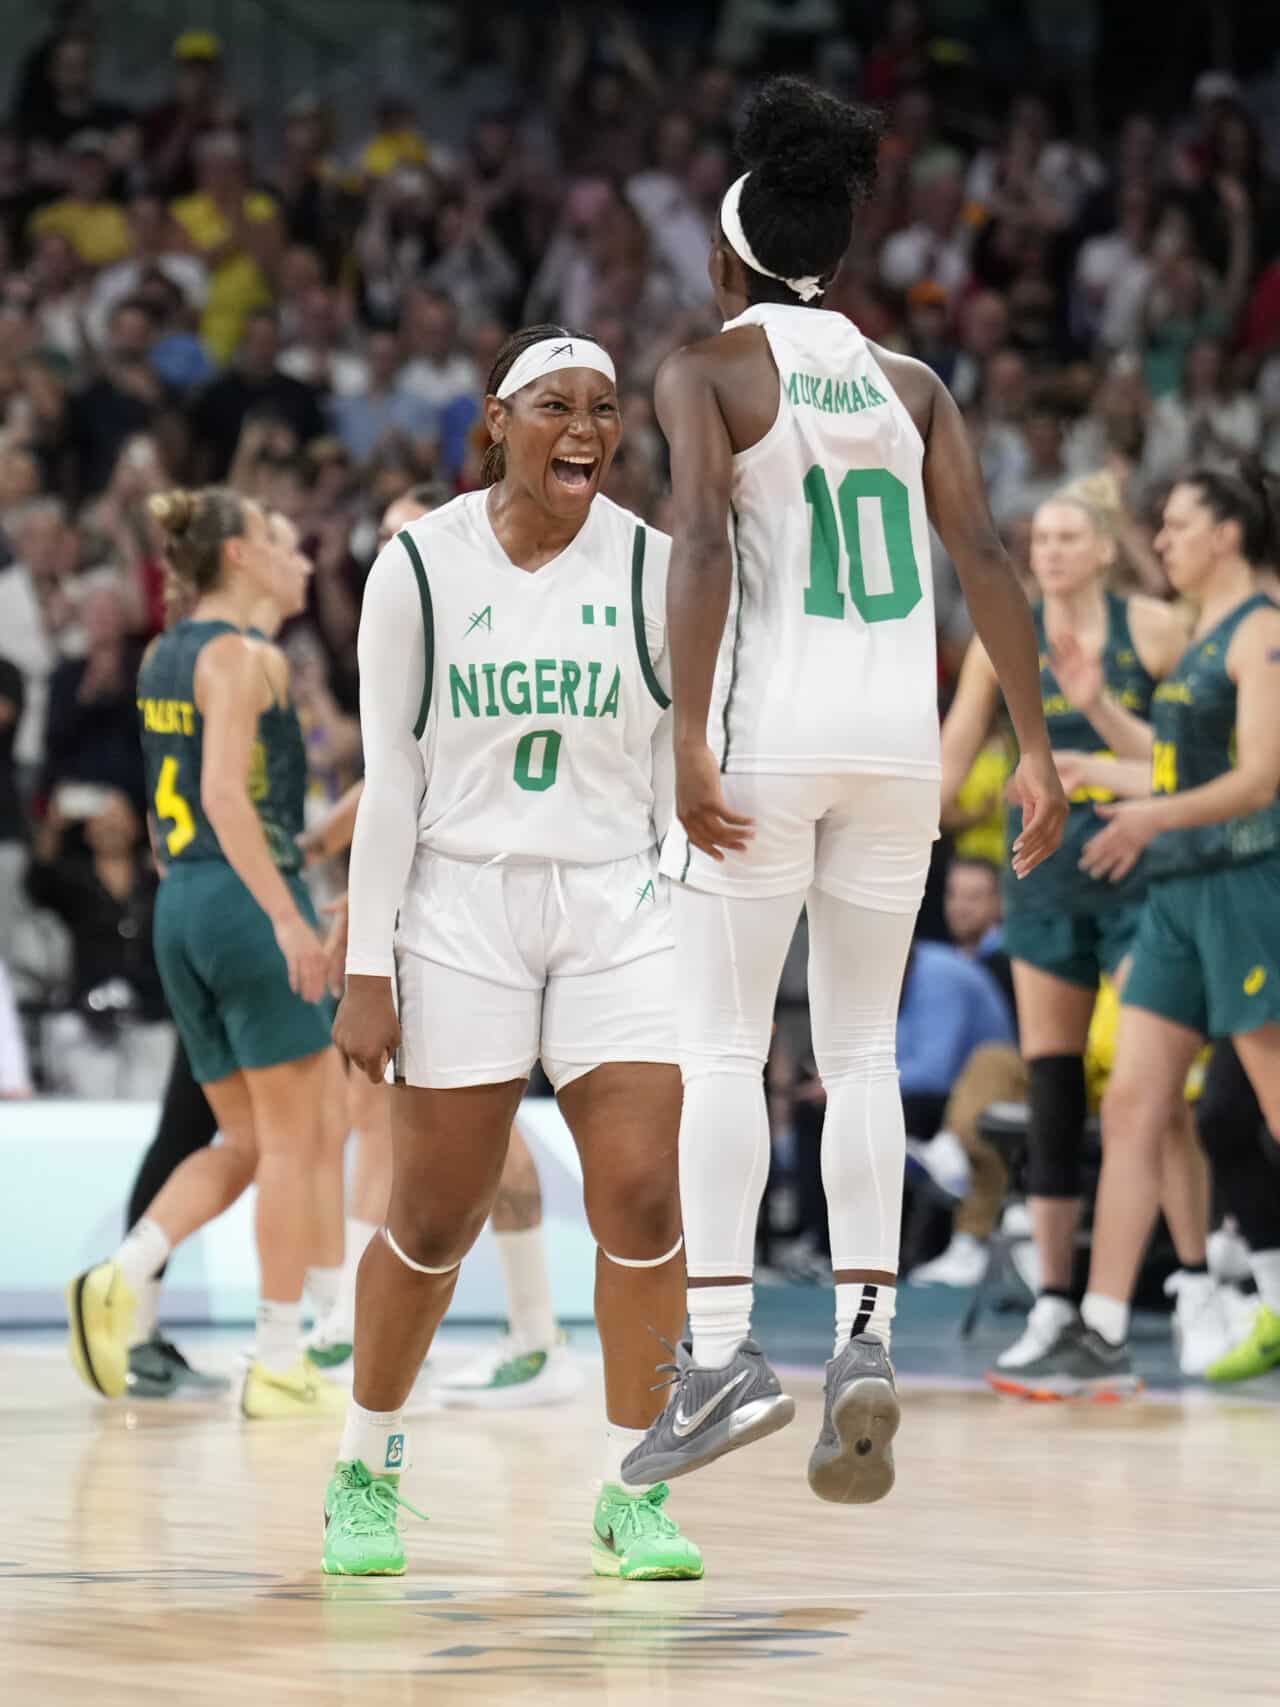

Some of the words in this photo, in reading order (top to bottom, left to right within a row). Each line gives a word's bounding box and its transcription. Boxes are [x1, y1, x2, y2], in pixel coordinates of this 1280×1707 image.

[802, 463, 923, 624] 10
[448, 658, 621, 719] NIGERIA
[512, 729, 563, 792] 0
[154, 754, 197, 857] 5
